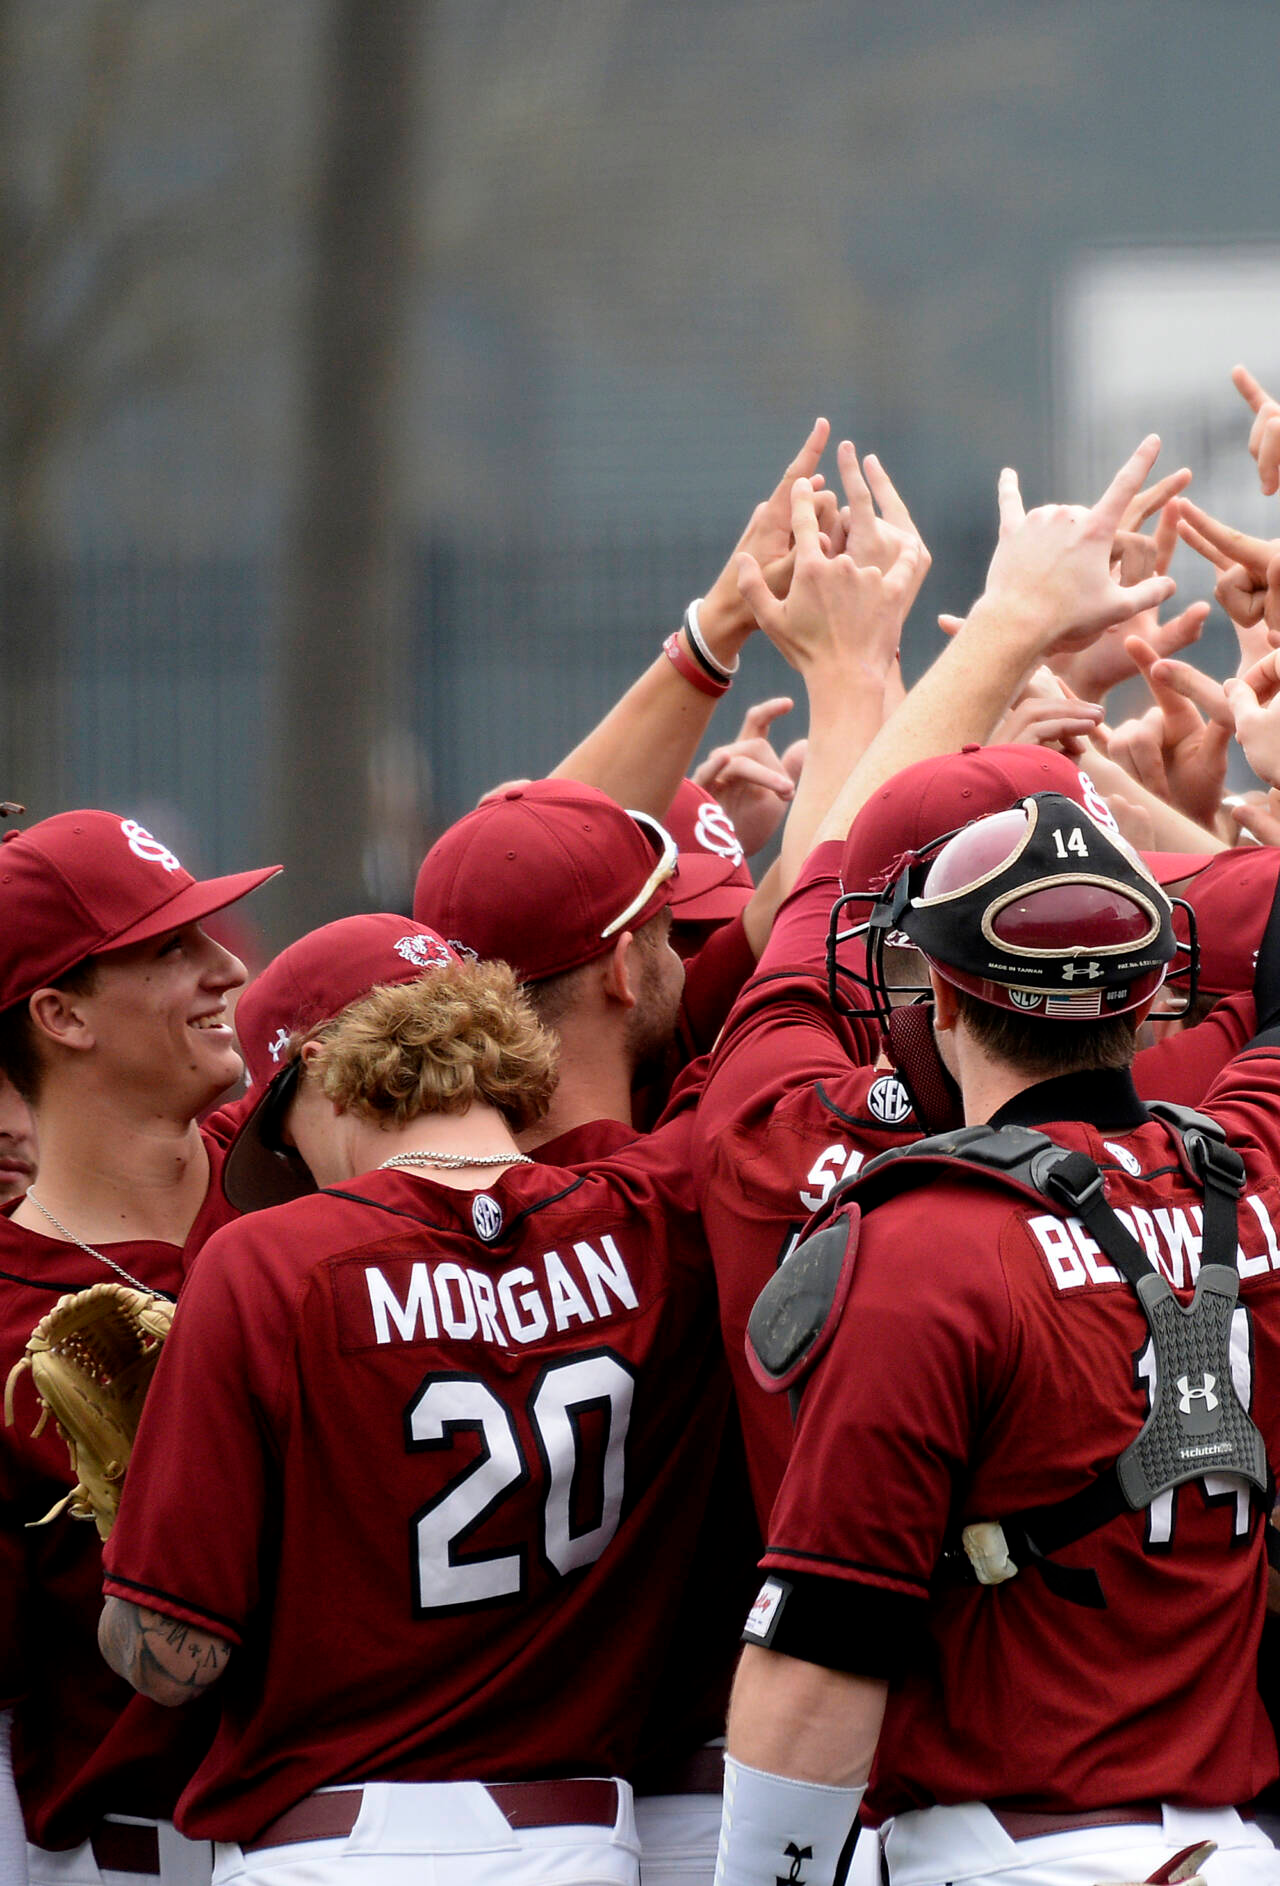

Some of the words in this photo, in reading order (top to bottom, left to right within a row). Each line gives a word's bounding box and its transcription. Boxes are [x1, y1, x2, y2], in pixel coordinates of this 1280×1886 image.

[1052, 827, 1089, 858] 14
[872, 1080, 910, 1120] SEC
[364, 1234, 640, 1348] MORGAN
[405, 1348, 638, 1616] 20
